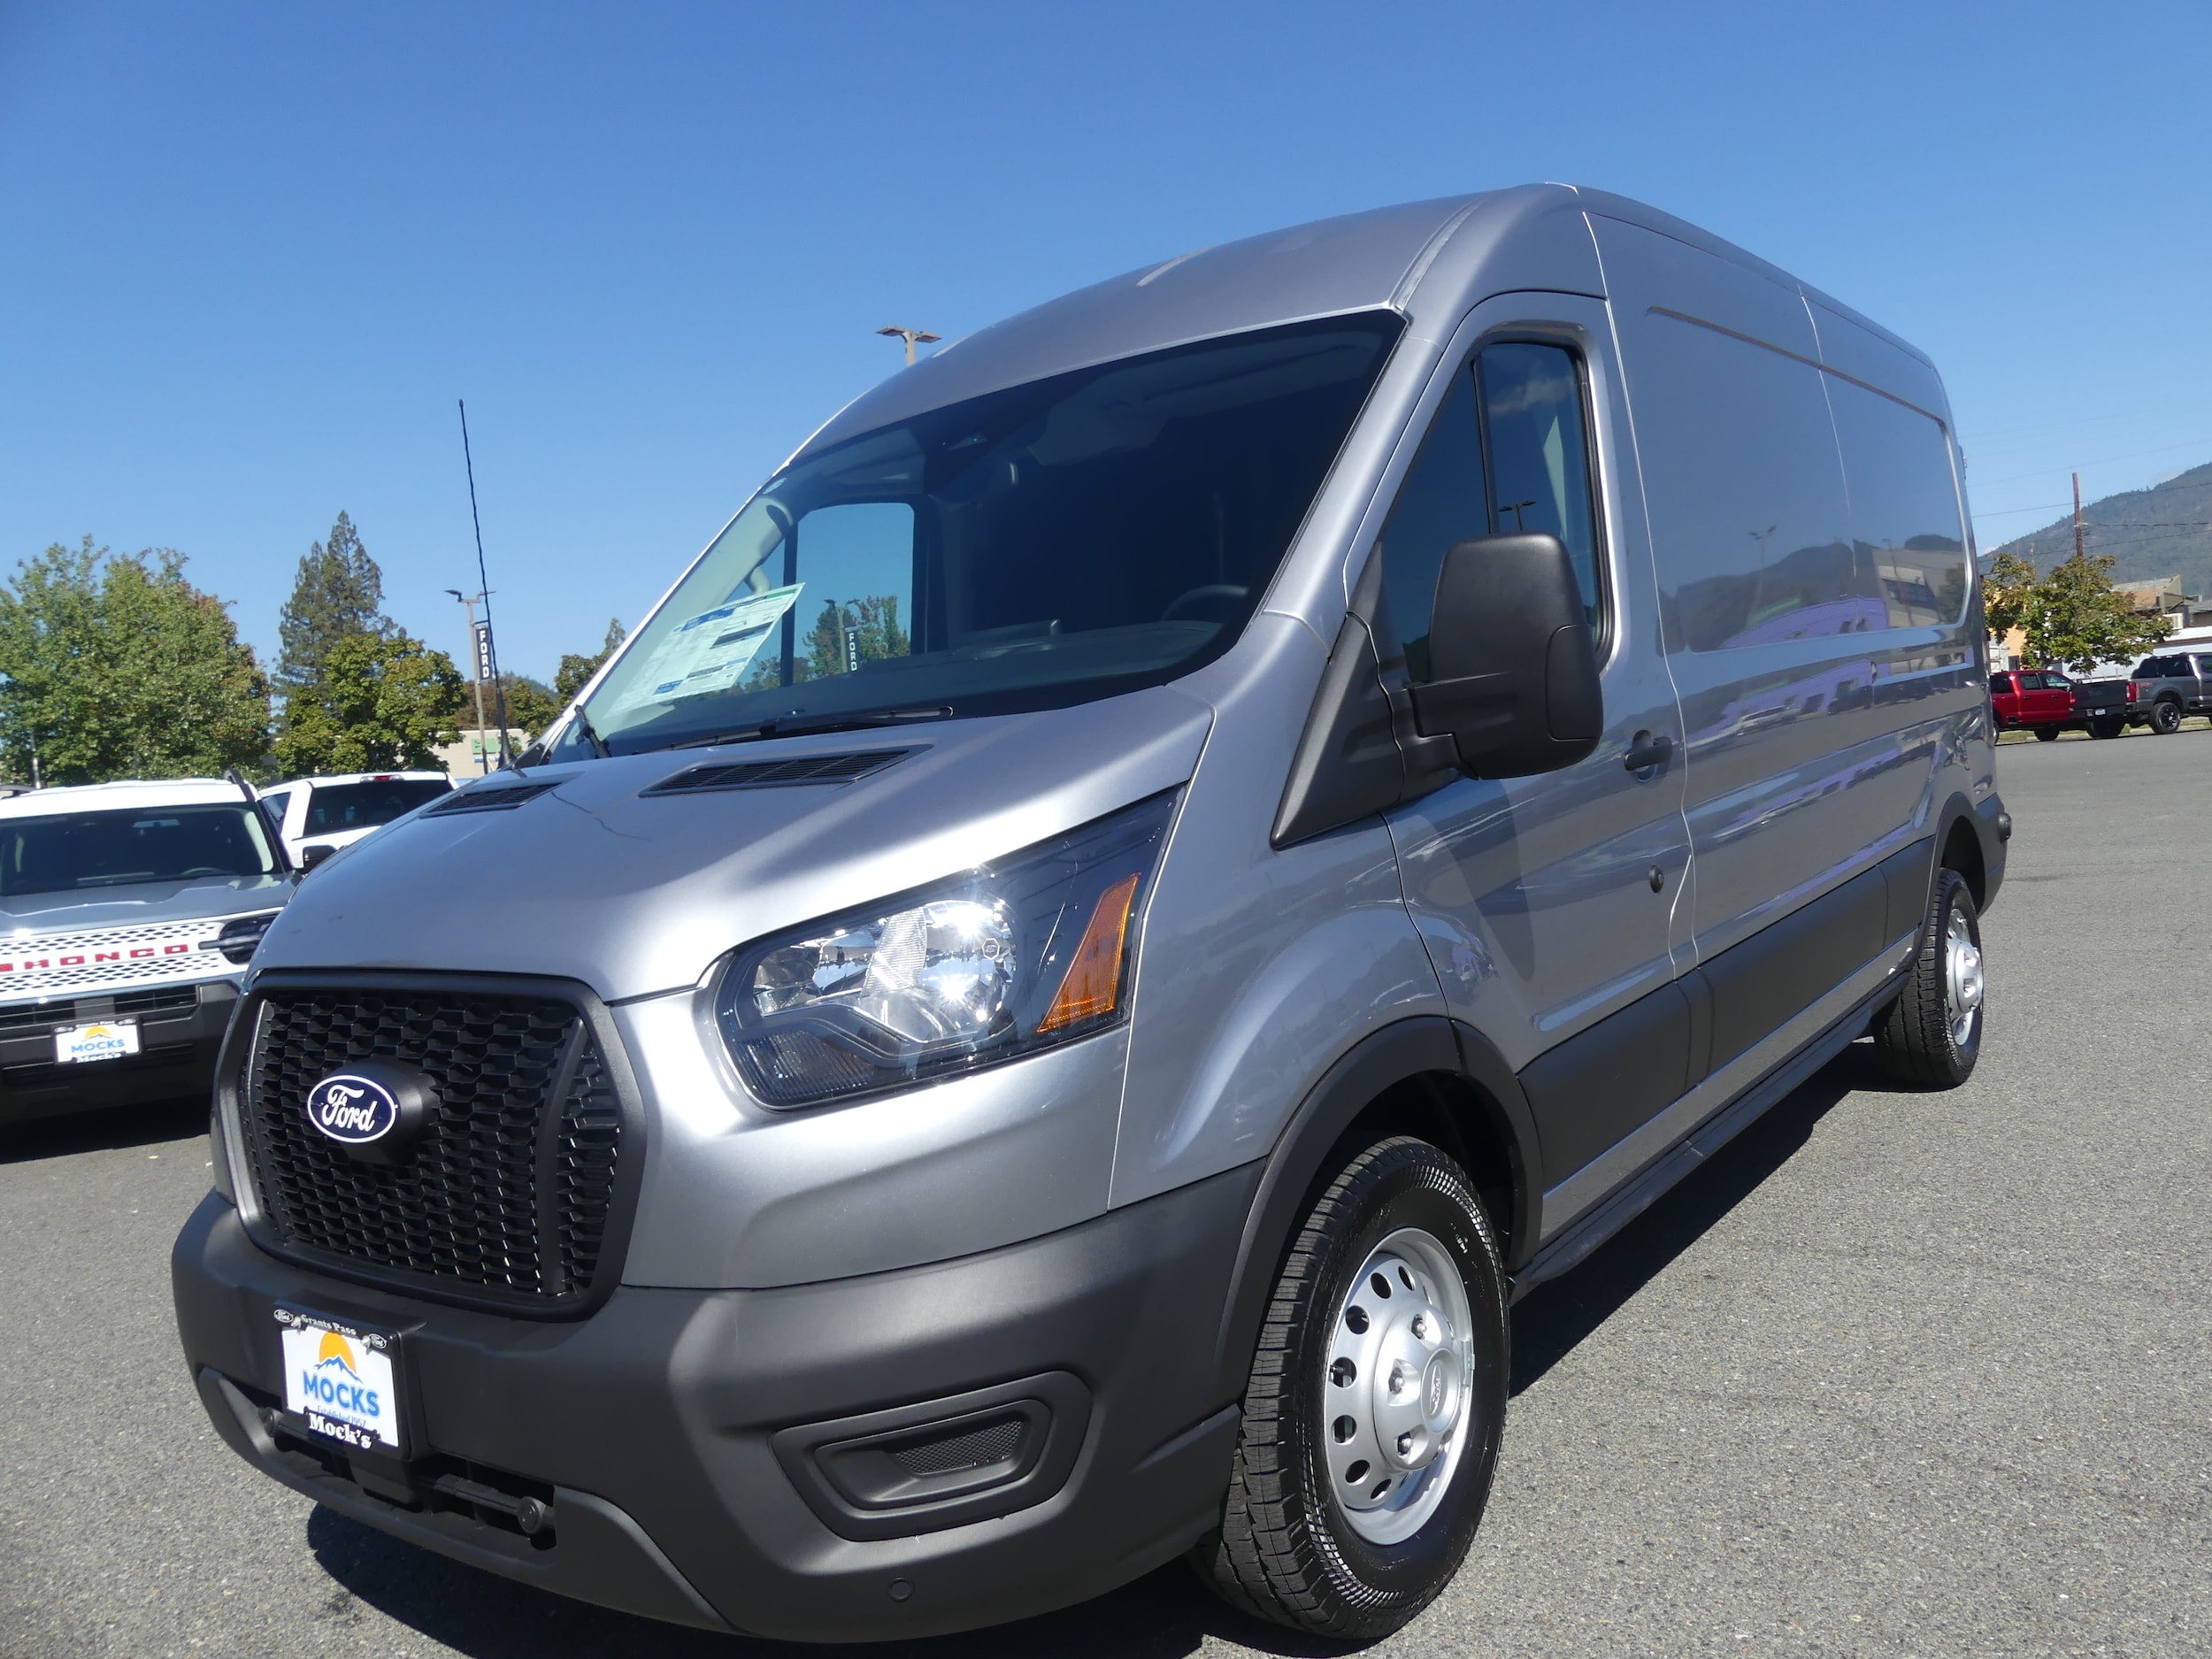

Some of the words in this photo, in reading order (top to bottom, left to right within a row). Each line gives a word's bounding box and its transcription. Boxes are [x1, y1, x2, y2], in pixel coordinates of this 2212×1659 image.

[479, 630, 490, 678] FORD
[849, 633, 857, 672] FORD
[71, 1039, 125, 1053] MOCKS
[321, 1084, 378, 1132] Ford
[332, 1322, 357, 1336] Pass
[303, 1370, 380, 1417] MOCKS
[308, 1412, 373, 1449] Mock's
